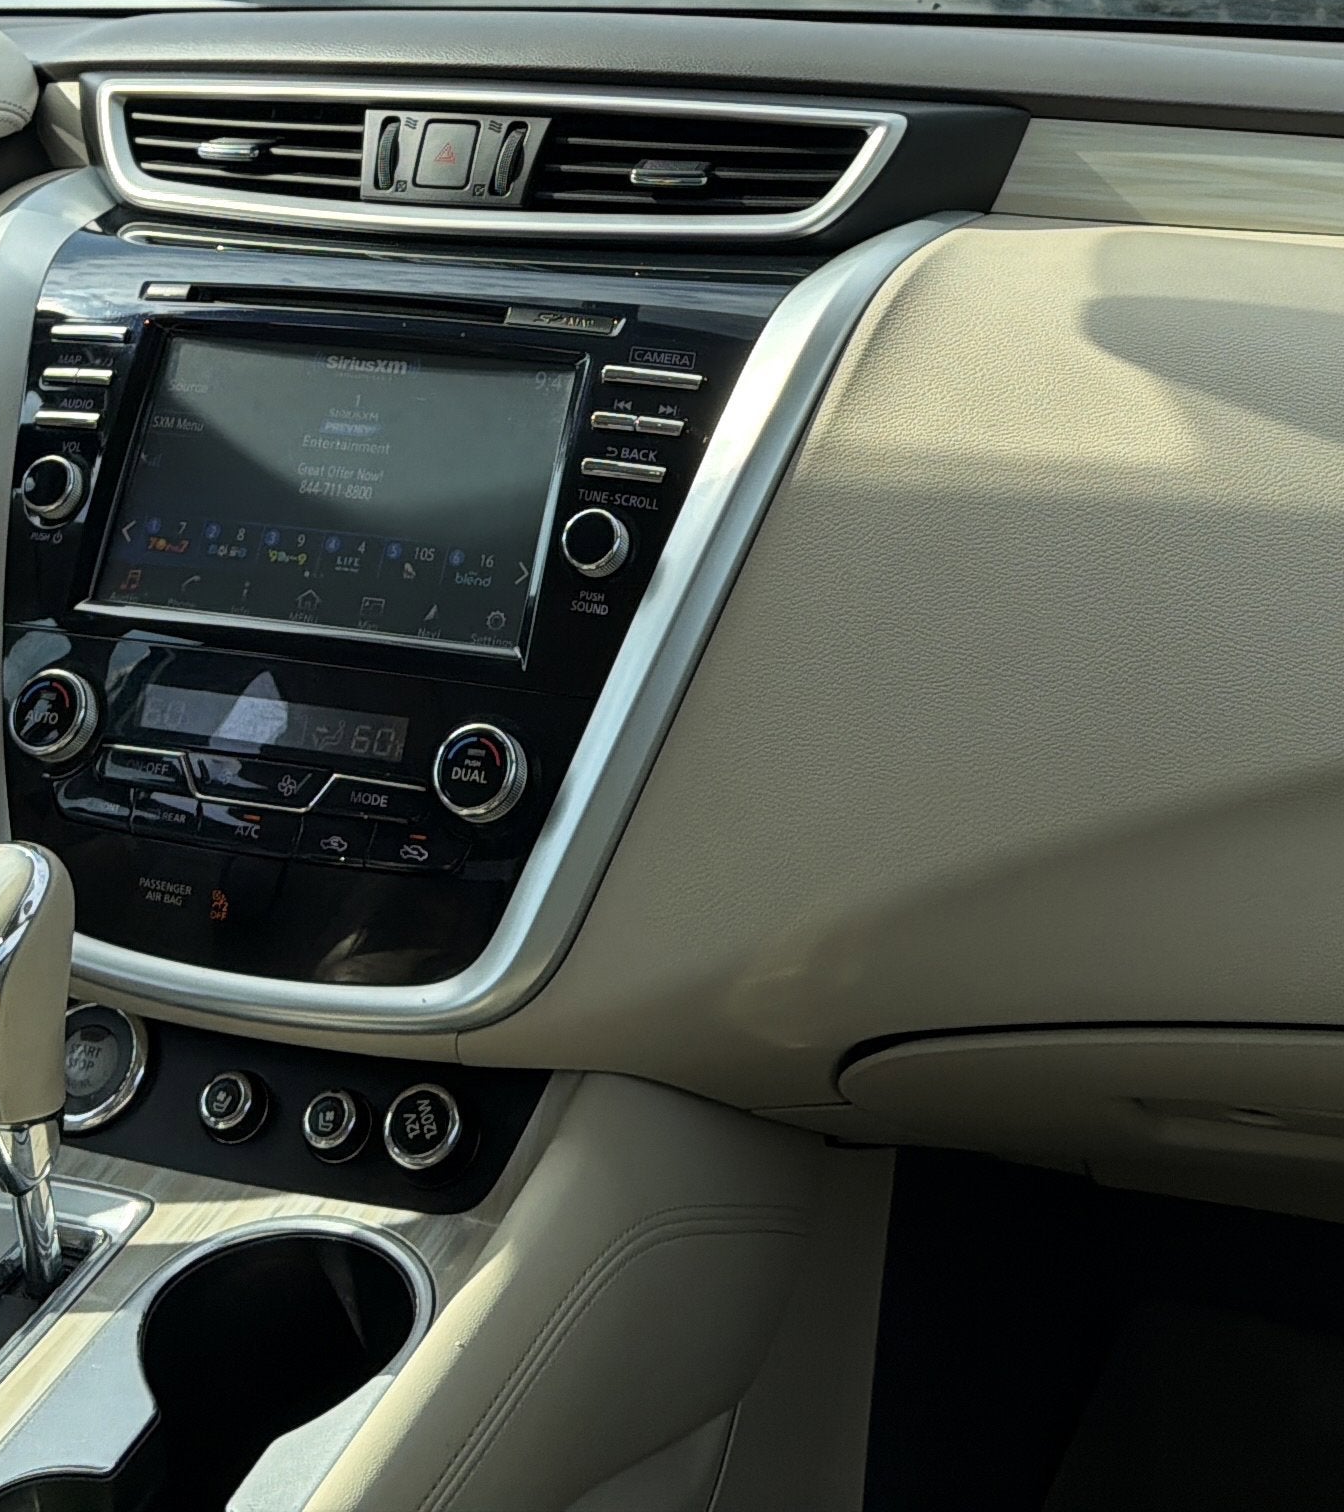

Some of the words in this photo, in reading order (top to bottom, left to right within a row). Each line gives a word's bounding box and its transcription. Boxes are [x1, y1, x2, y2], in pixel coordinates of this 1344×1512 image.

[57, 353, 83, 365] MAP
[634, 350, 691, 366] CAMERA
[60, 397, 94, 410] AUDIO
[151, 414, 175, 430] SXM
[176, 417, 205, 433] Menu
[62, 440, 81, 453] VOL
[301, 434, 393, 456] Entertainment
[620, 447, 658, 462] BACK
[297, 462, 326, 478] Great
[327, 464, 355, 479] Offer
[357, 467, 385, 483] Now!
[296, 533, 307, 548] 9
[356, 540, 366, 554] 4
[413, 546, 436, 562] 105
[480, 553, 495, 569] 16
[454, 571, 492, 588] blend
[579, 590, 605, 602] PUSH
[570, 600, 609, 616] SOUND
[23, 711, 60, 726] AUTO
[464, 758, 482, 768] PUSH
[450, 766, 489, 785] DUAL
[349, 789, 390, 808] MODE
[161, 810, 187, 824] REAR
[234, 823, 262, 839] A/C
[138, 876, 193, 896] PASSENGER
[145, 890, 163, 903] AIR
[163, 893, 183, 907] BAG
[209, 910, 228, 921] OFF
[68, 1042, 104, 1059] START
[67, 1057, 95, 1072] STOP
[402, 1113, 421, 1140] 12V
